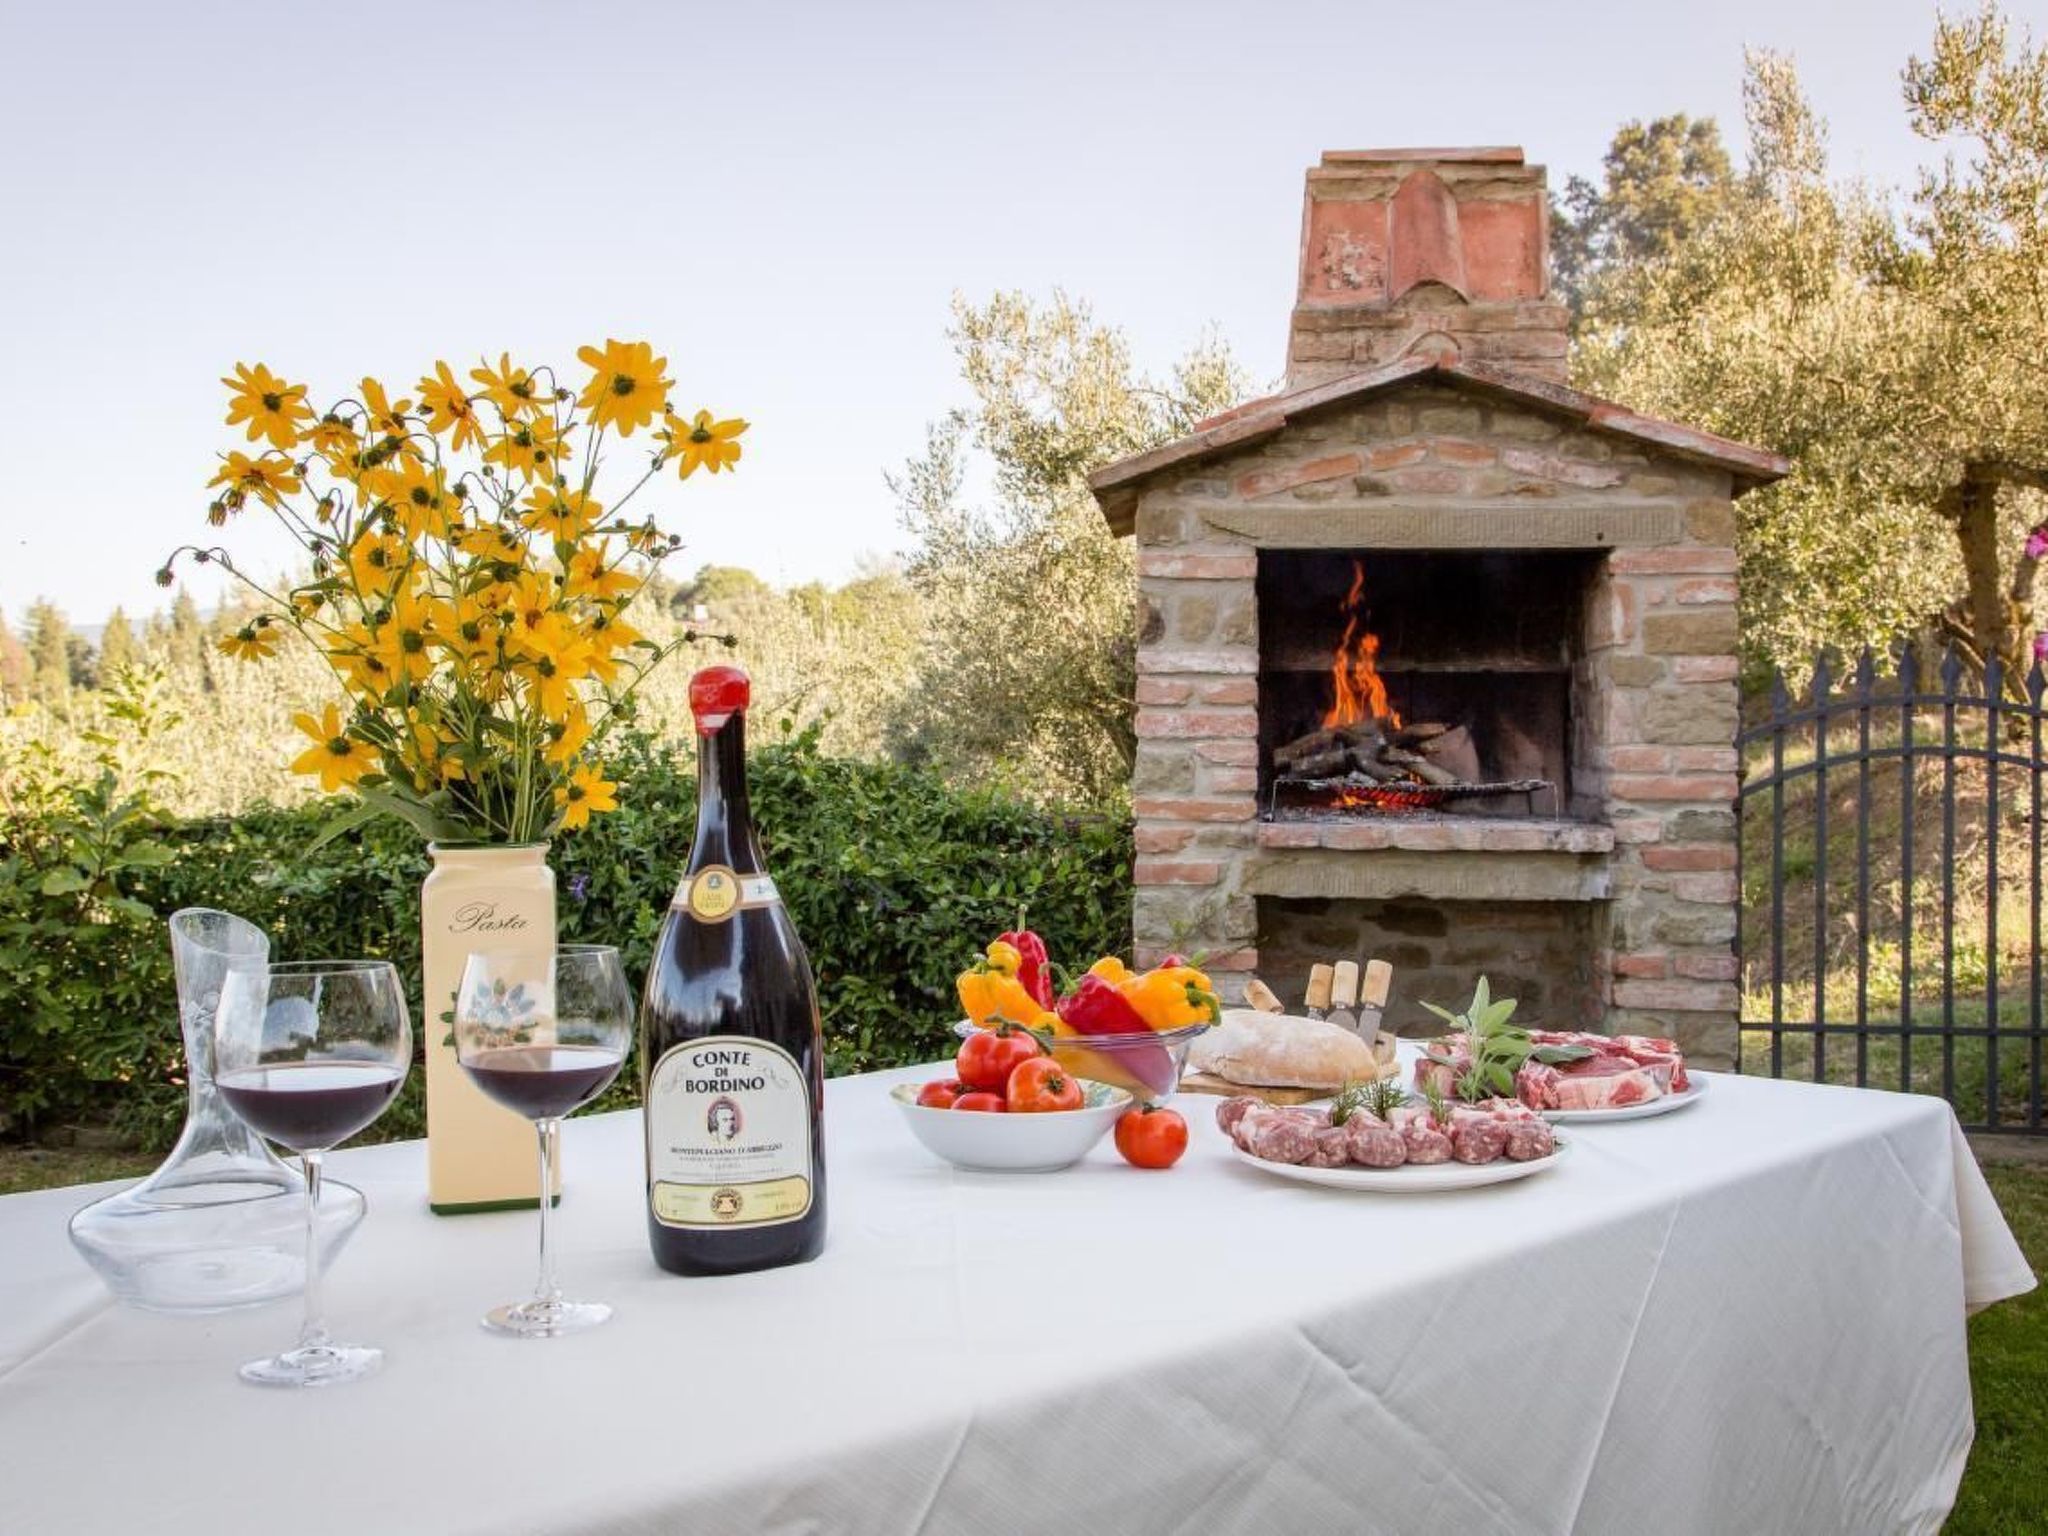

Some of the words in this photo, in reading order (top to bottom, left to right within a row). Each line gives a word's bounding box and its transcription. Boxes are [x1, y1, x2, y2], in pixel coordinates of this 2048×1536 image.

[448, 900, 528, 933] Pasta
[693, 1051, 751, 1067] CONTE
[715, 1067, 728, 1077] DI
[686, 1076, 765, 1093] BORDINO
